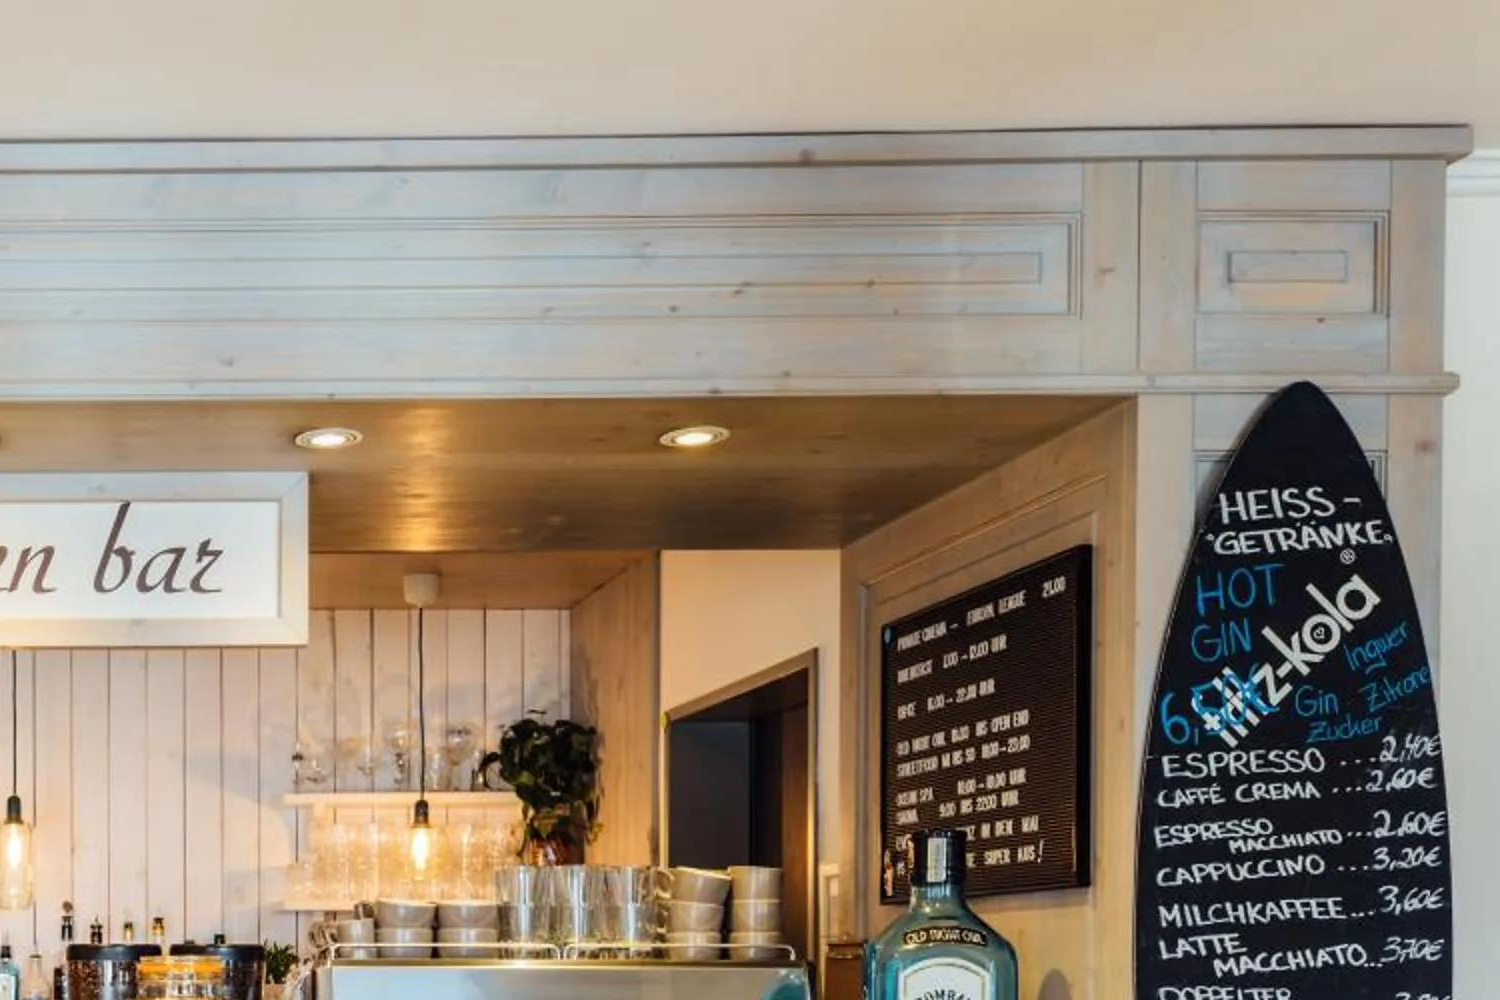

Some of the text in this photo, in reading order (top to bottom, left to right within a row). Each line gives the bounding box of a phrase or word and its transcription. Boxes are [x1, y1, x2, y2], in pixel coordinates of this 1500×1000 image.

[94, 501, 223, 594] bar
[1196, 563, 1285, 616] HOT
[1191, 617, 1251, 663] GIN
[1295, 685, 1339, 716] Gin
[1306, 715, 1383, 753] Zucker
[1161, 748, 1325, 779] ESPRESSO
[1235, 781, 1322, 803] CREMA
[1365, 767, 1438, 793] 2,60€
[1154, 809, 1446, 848] ESPRESSO 2,60€
[1229, 828, 1344, 855] MACCHIATO
[1156, 846, 1443, 886] CAPPUCCINO 3,20€
[1158, 897, 1349, 929] MILCHKAFFEE
[1159, 932, 1248, 960] LATTE
[1213, 943, 1368, 979] MACCHIATO
